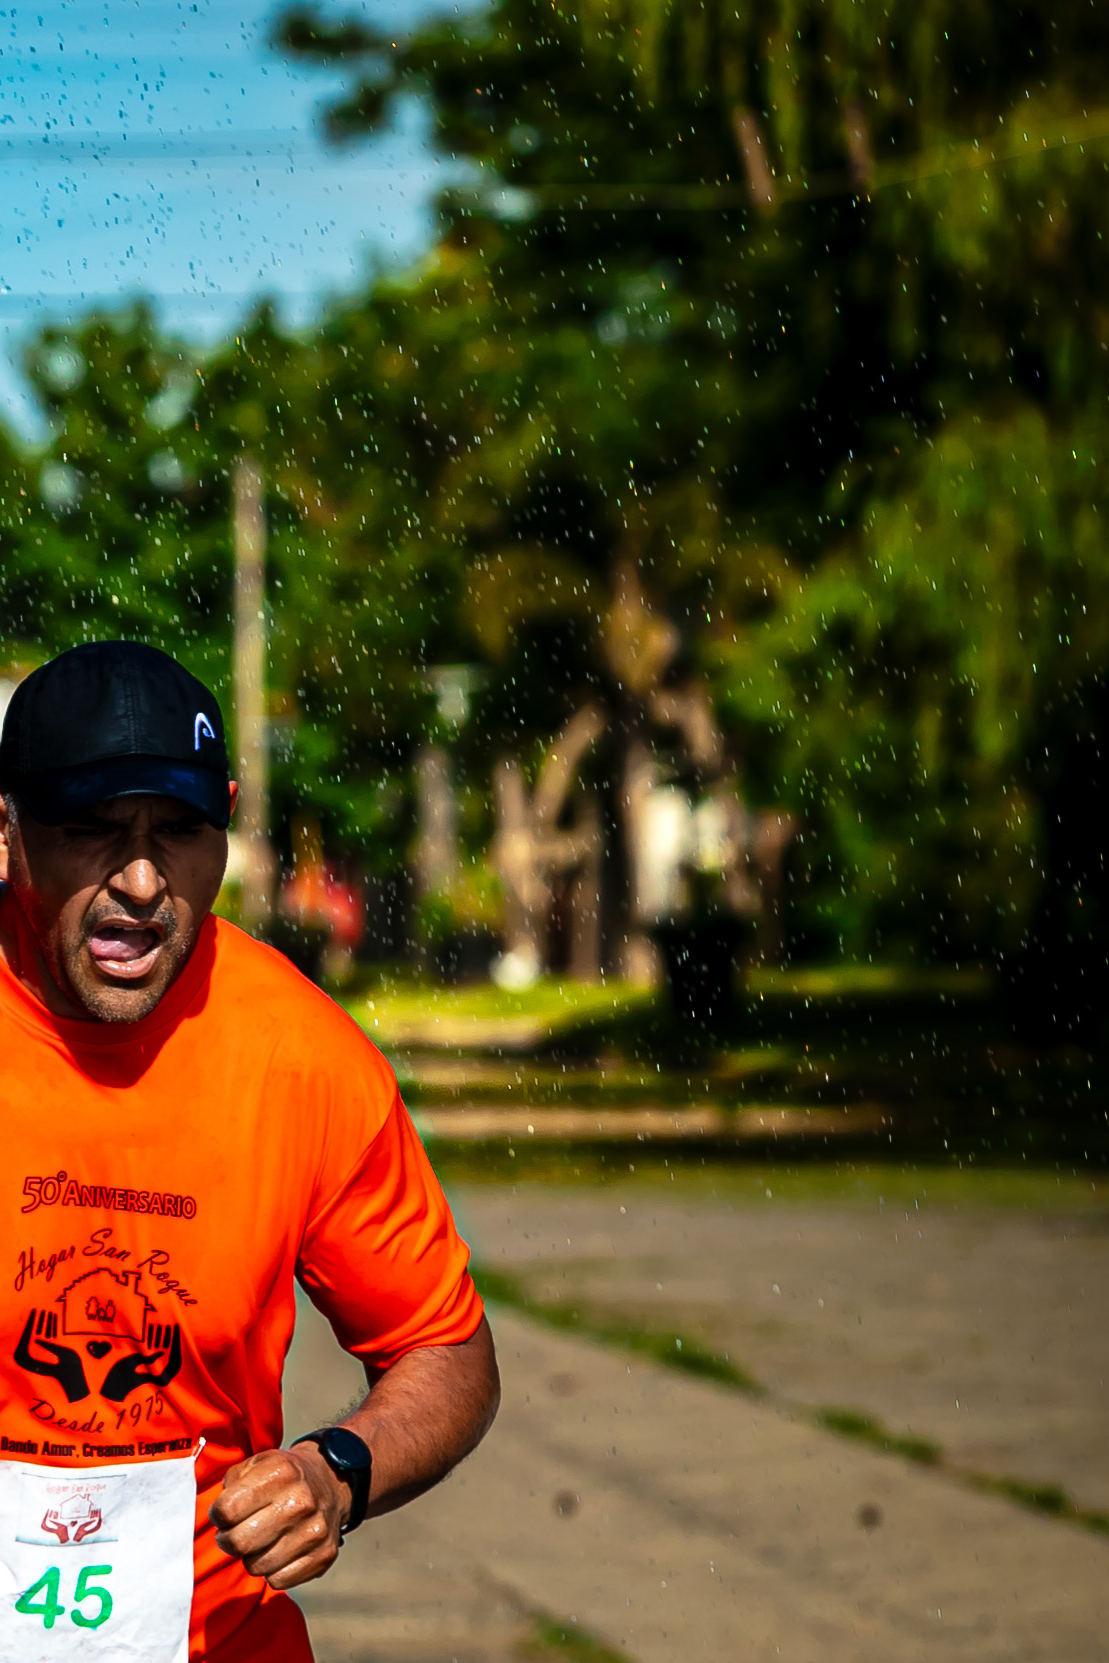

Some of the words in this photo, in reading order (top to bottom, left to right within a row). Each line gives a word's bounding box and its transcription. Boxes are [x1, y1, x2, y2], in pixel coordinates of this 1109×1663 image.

[62, 1180, 197, 1219] ANIVERSARIO
[14, 1246, 76, 1291] Hogar
[82, 1228, 131, 1261] San
[29, 1397, 105, 1433] Desde
[0, 1436, 39, 1456] Dando
[82, 1442, 136, 1458] Creamos
[138, 1436, 192, 1457] Esperanza
[15, 1564, 114, 1630] 45
